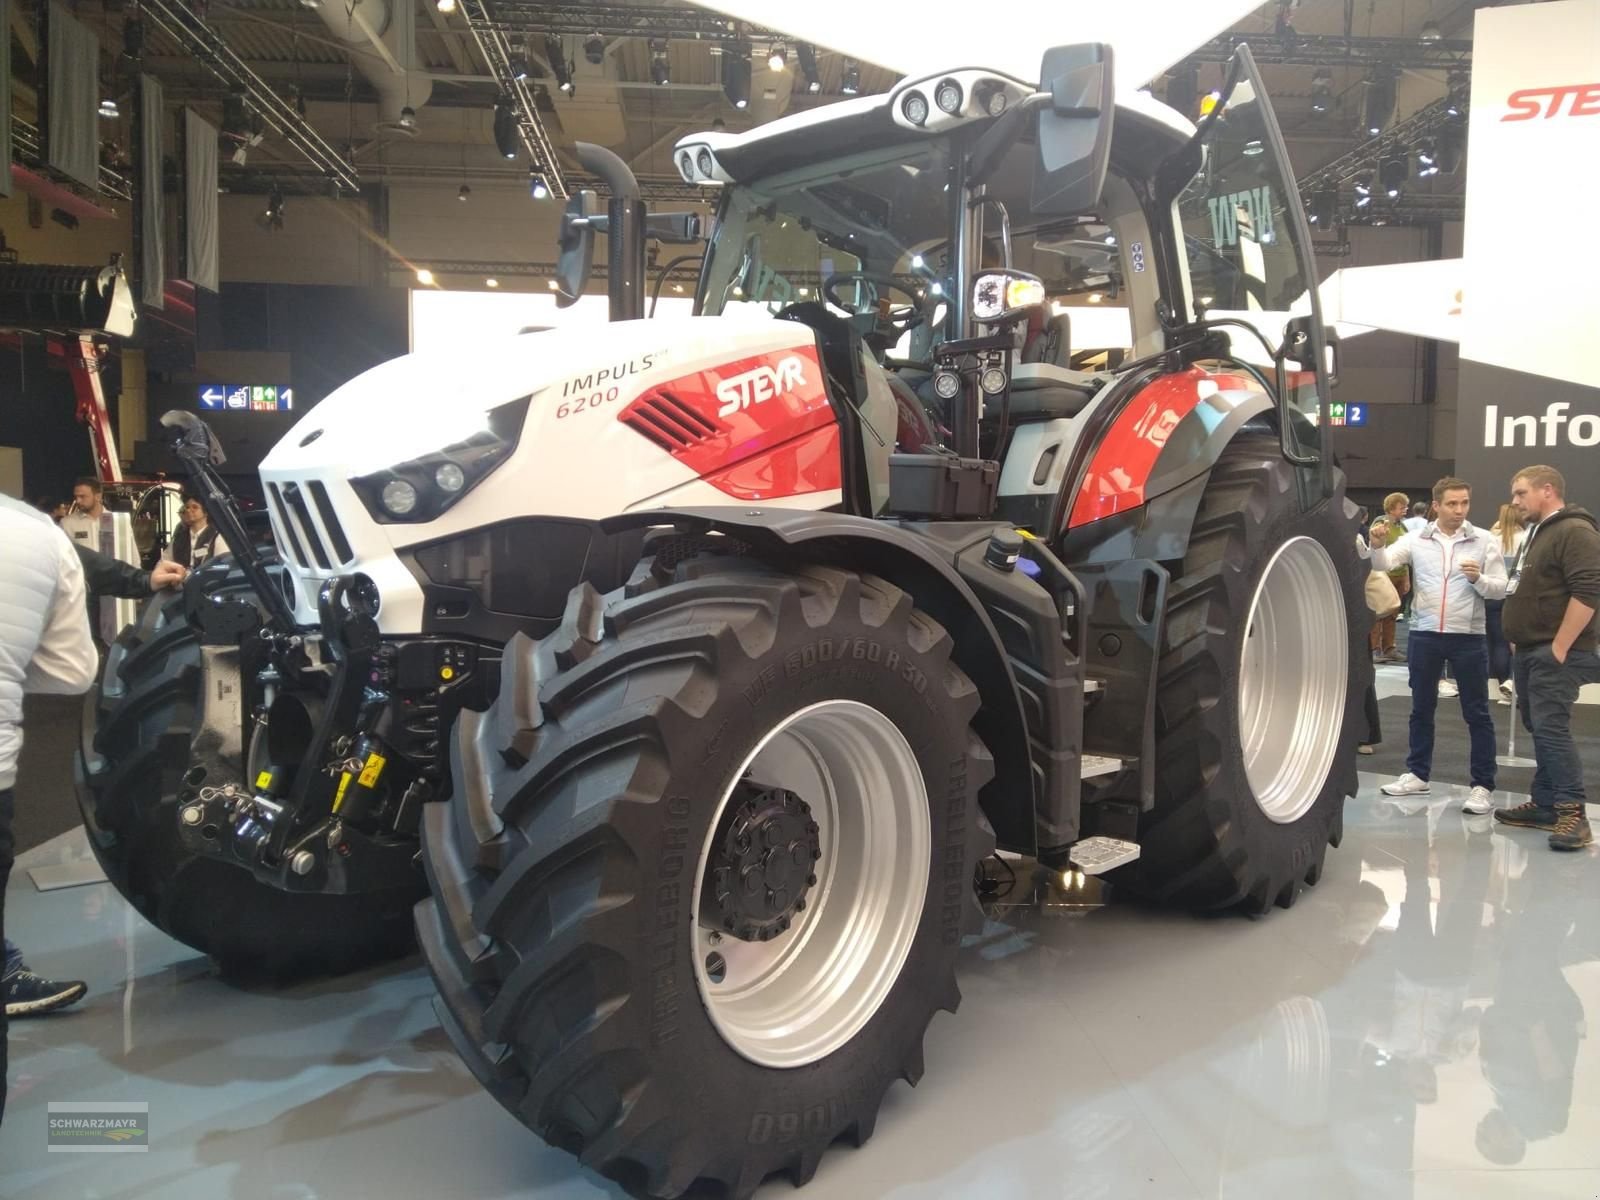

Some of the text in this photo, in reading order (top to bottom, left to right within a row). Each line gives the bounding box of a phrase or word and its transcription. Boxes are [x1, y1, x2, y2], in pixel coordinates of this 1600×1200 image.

[563, 354, 653, 397] IMPULS
[716, 356, 807, 418] STEYR
[280, 389, 292, 409] 1
[556, 386, 619, 419] 6200
[1351, 406, 1361, 421] 2
[1484, 402, 1600, 447] Info
